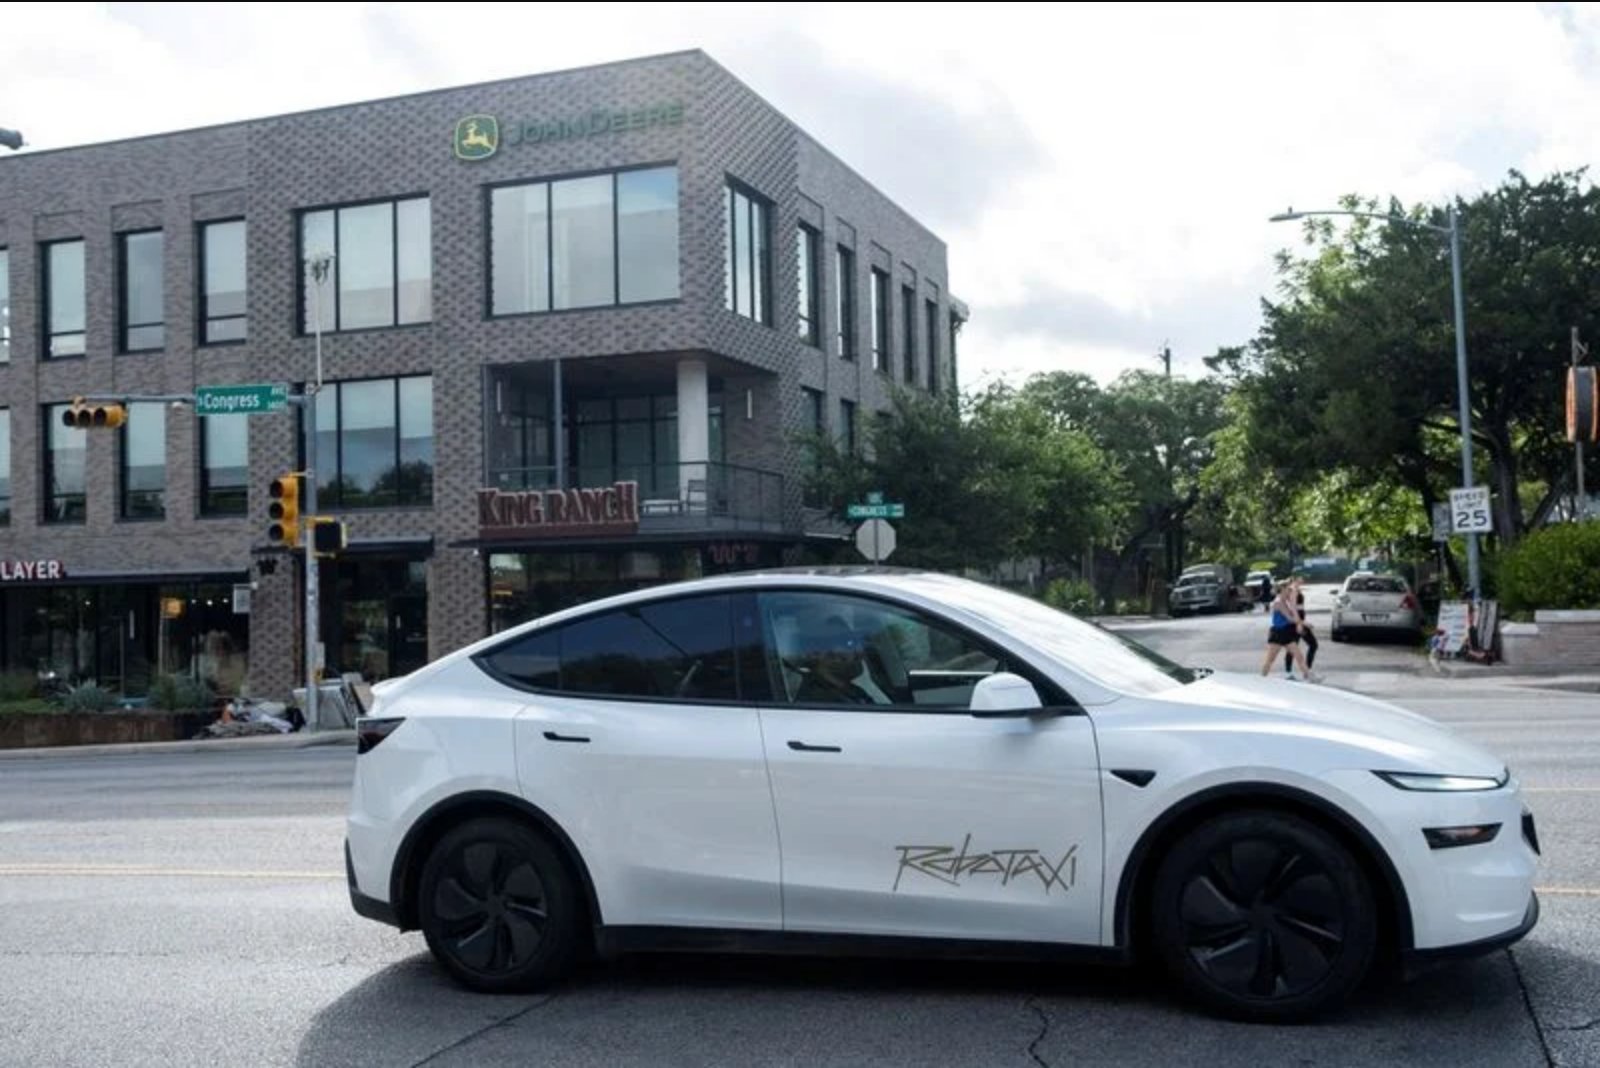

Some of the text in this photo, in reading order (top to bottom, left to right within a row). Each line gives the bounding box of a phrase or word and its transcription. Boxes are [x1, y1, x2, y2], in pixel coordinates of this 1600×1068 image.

[204, 393, 260, 411] Congress
[478, 481, 639, 527] KING RANCH
[1456, 510, 1487, 529] 25
[1, 560, 61, 579] LAYER
